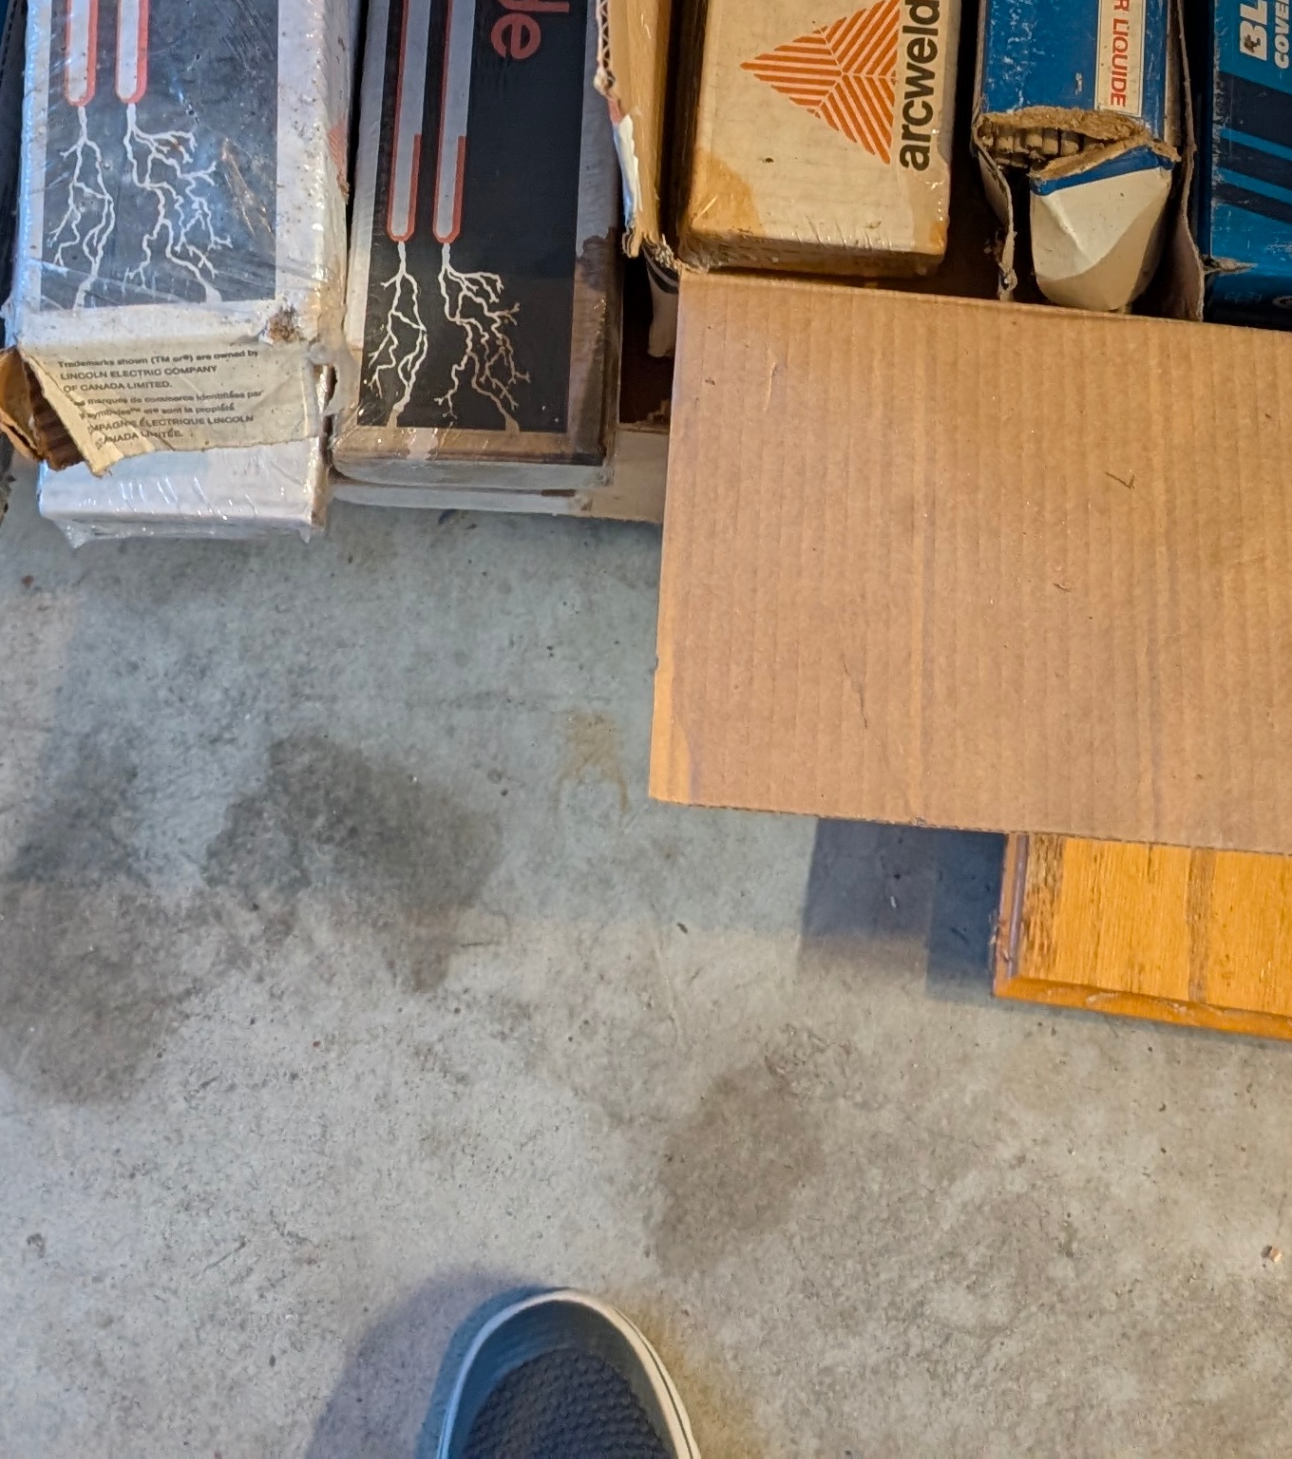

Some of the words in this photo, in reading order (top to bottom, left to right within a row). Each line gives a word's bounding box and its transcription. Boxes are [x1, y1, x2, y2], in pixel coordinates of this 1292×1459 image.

[1110, 18, 1130, 108] LIQUIDE
[247, 349, 259, 358] by
[60, 370, 108, 380] LINCOLN
[110, 367, 163, 379] ELECTRIC
[164, 365, 218, 376] COMPANY
[63, 383, 79, 393] OF
[80, 382, 126, 392] CANADA
